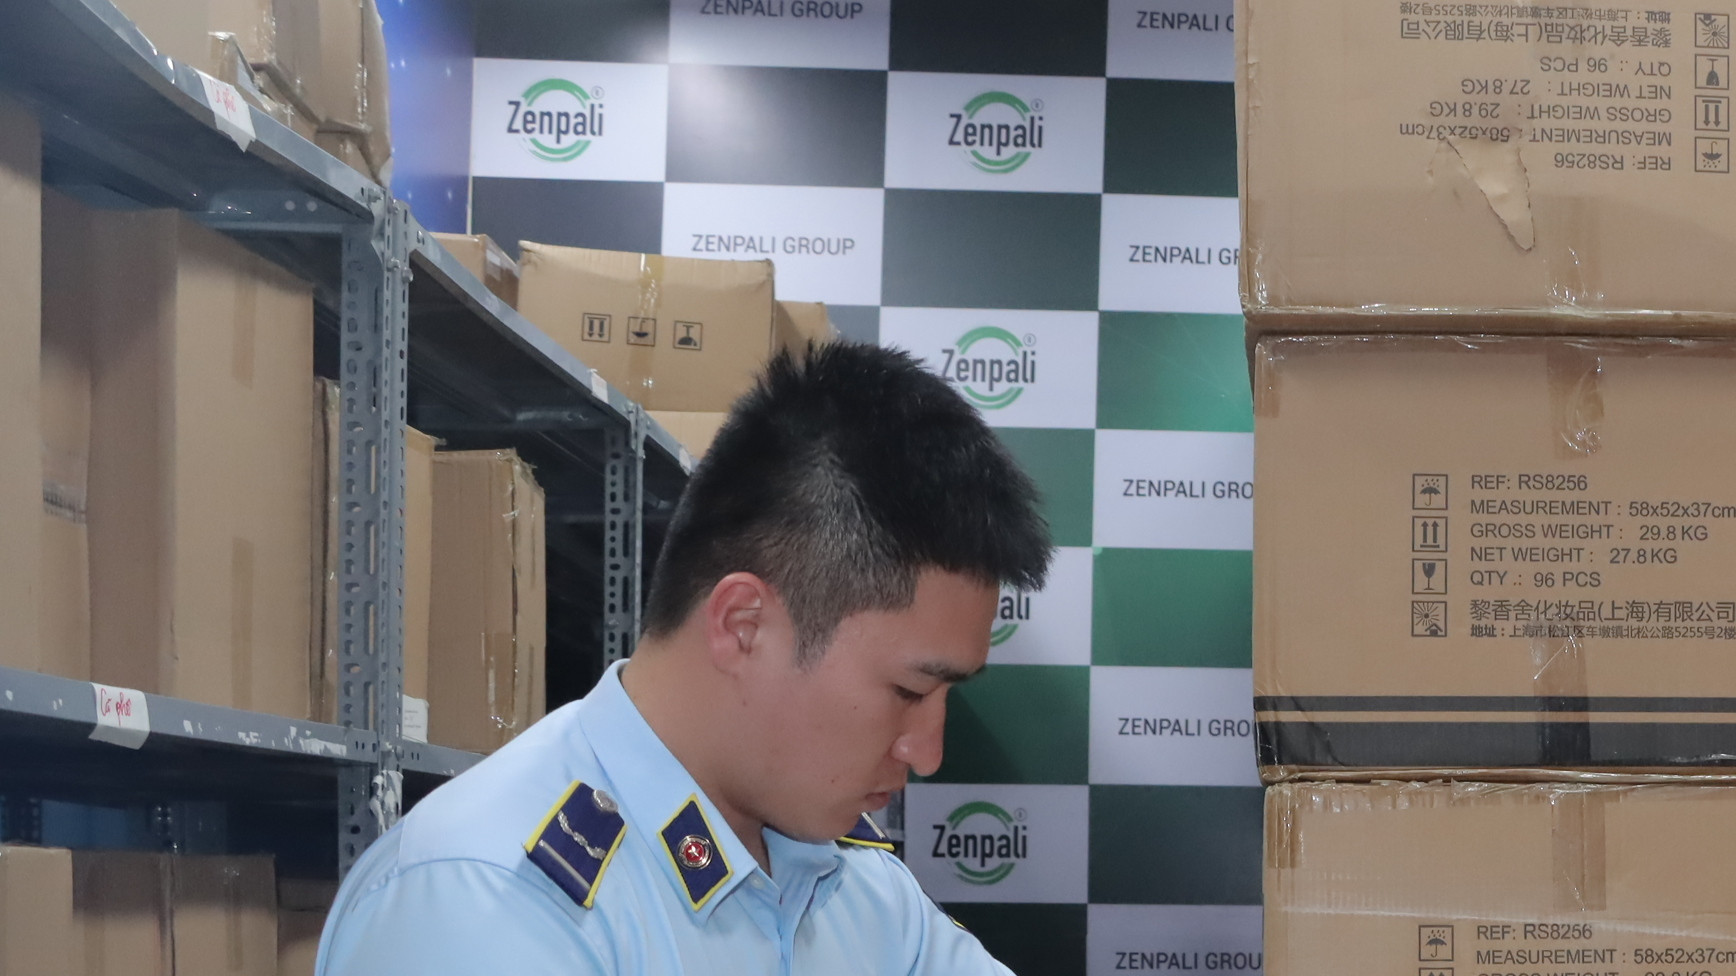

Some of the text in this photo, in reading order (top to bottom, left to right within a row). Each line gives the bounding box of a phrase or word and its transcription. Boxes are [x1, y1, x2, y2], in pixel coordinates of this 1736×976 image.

[700, 0, 864, 19] ZENPALI GROUP
[1136, 11, 1219, 32] ZENPALI
[1540, 56, 1579, 72] PCS
[1587, 57, 1608, 73] 96
[507, 100, 604, 144] Zenpali
[948, 113, 1043, 156] Zenpali
[1400, 124, 1511, 141] 58x52x37cm
[1554, 153, 1671, 171] REF: RS8256
[692, 234, 855, 255] ZENPALI GROUP
[1128, 245, 1211, 265] ZENPALI
[941, 348, 1036, 391] Zenpali
[1122, 479, 1254, 500] ZENPALI GRO
[1471, 474, 1588, 491] REF: RS8256
[1628, 501, 1736, 518] 58x52x37cm
[1470, 523, 1536, 539] GROSS
[1470, 547, 1506, 562] NET
[1533, 572, 1555, 588] 96
[1562, 571, 1602, 588] PCS
[1118, 718, 1254, 738] ZENPALI GRO
[931, 824, 1028, 868] Zenpali
[1476, 923, 1593, 941] REF: RS8256
[1116, 952, 1263, 971] ZENPALI GROU
